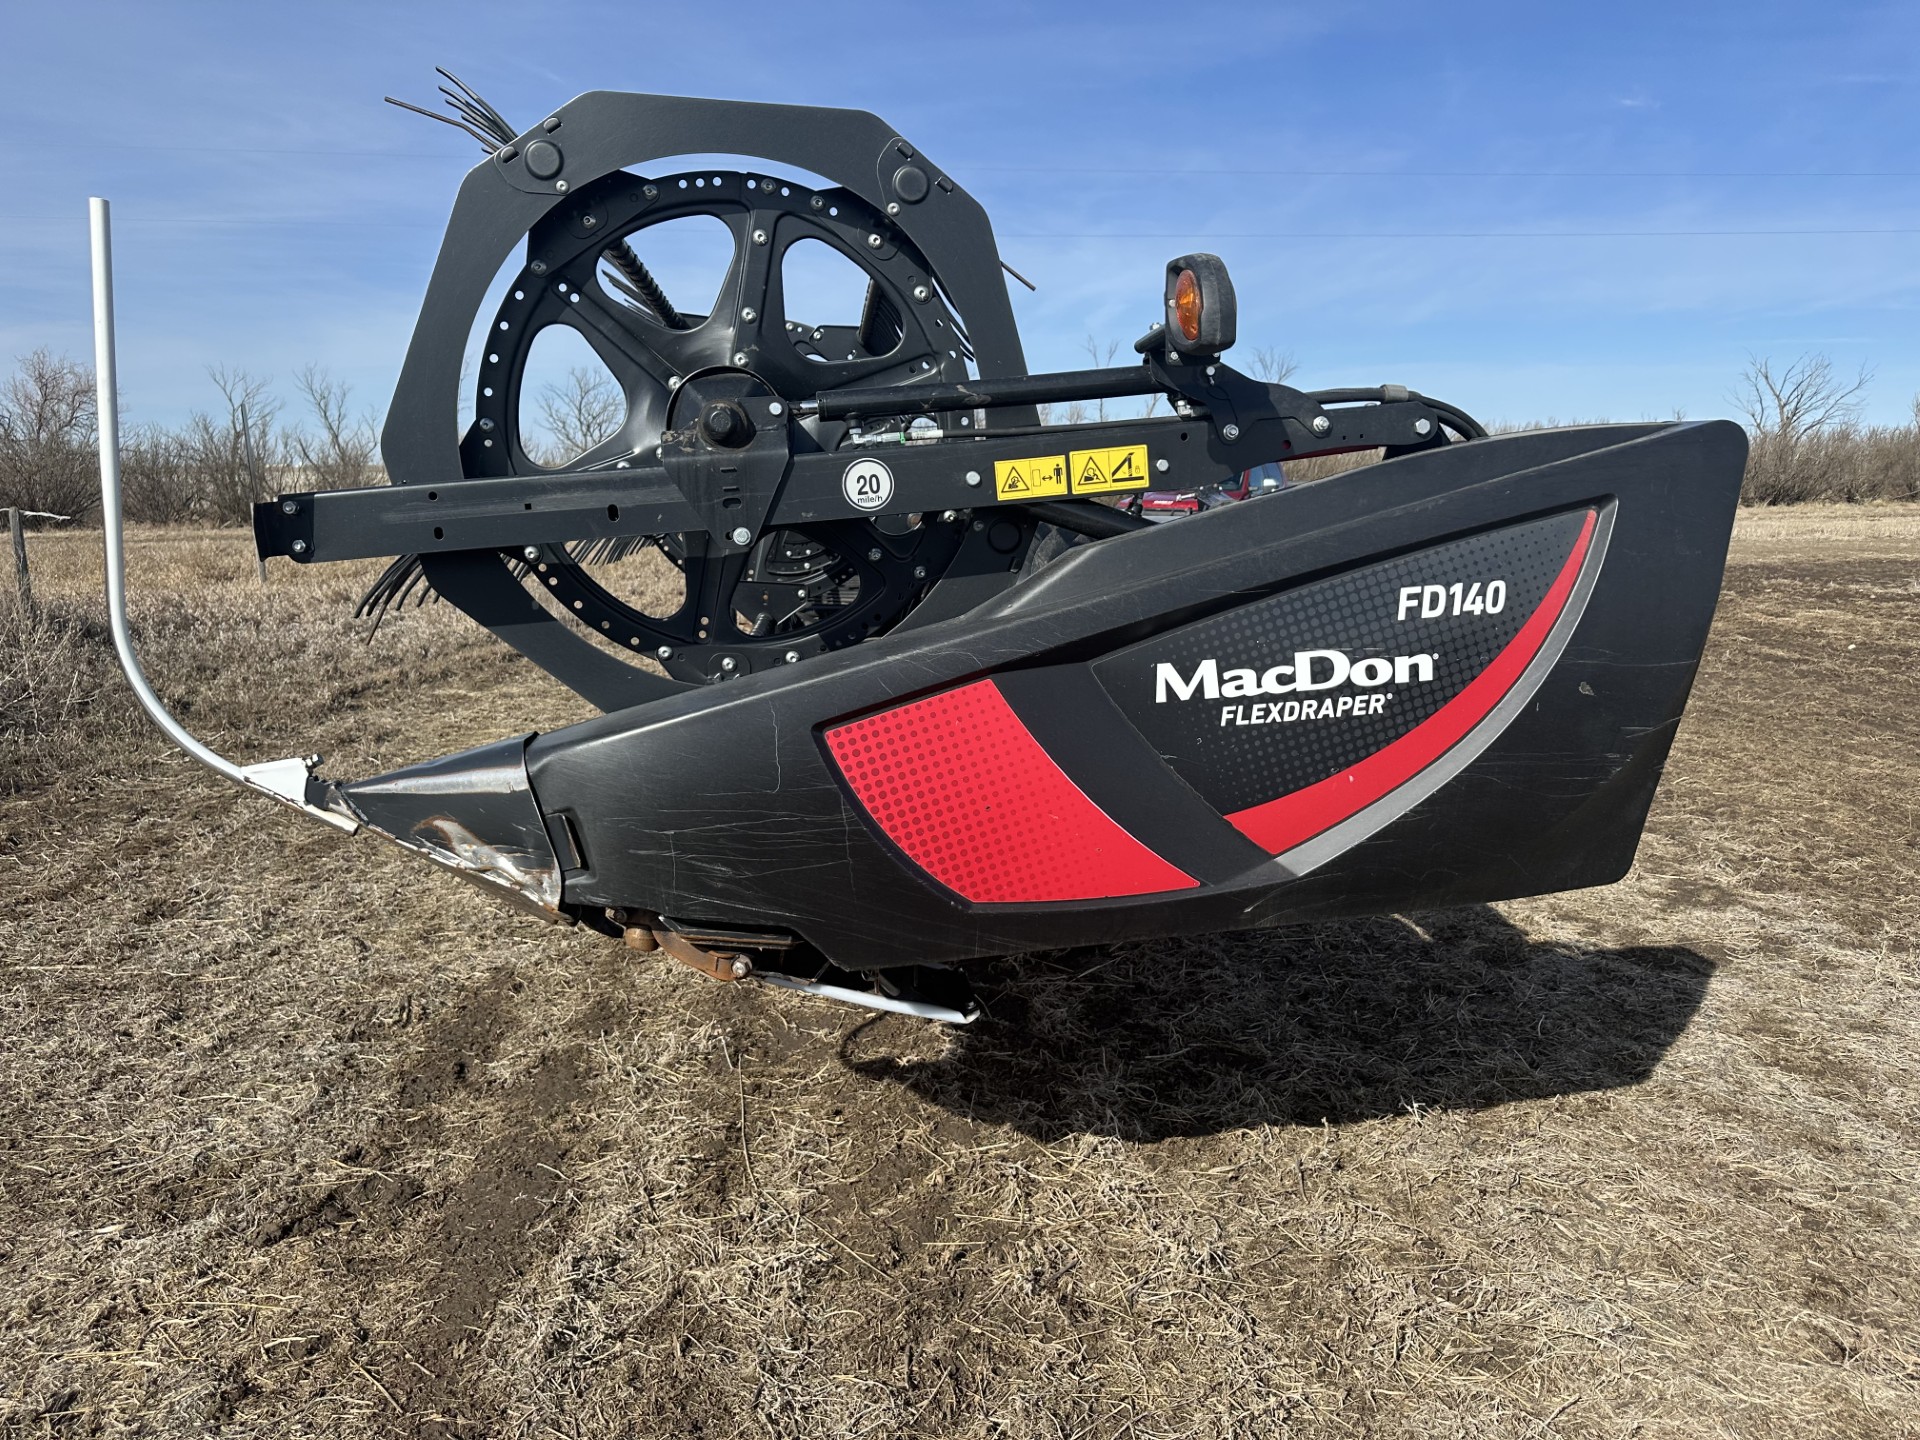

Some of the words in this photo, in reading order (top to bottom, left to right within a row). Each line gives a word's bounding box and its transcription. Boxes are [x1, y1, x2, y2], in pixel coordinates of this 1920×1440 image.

[856, 474, 881, 496] 20
[857, 495, 883, 504] mile/h
[1397, 580, 1506, 620] FD140
